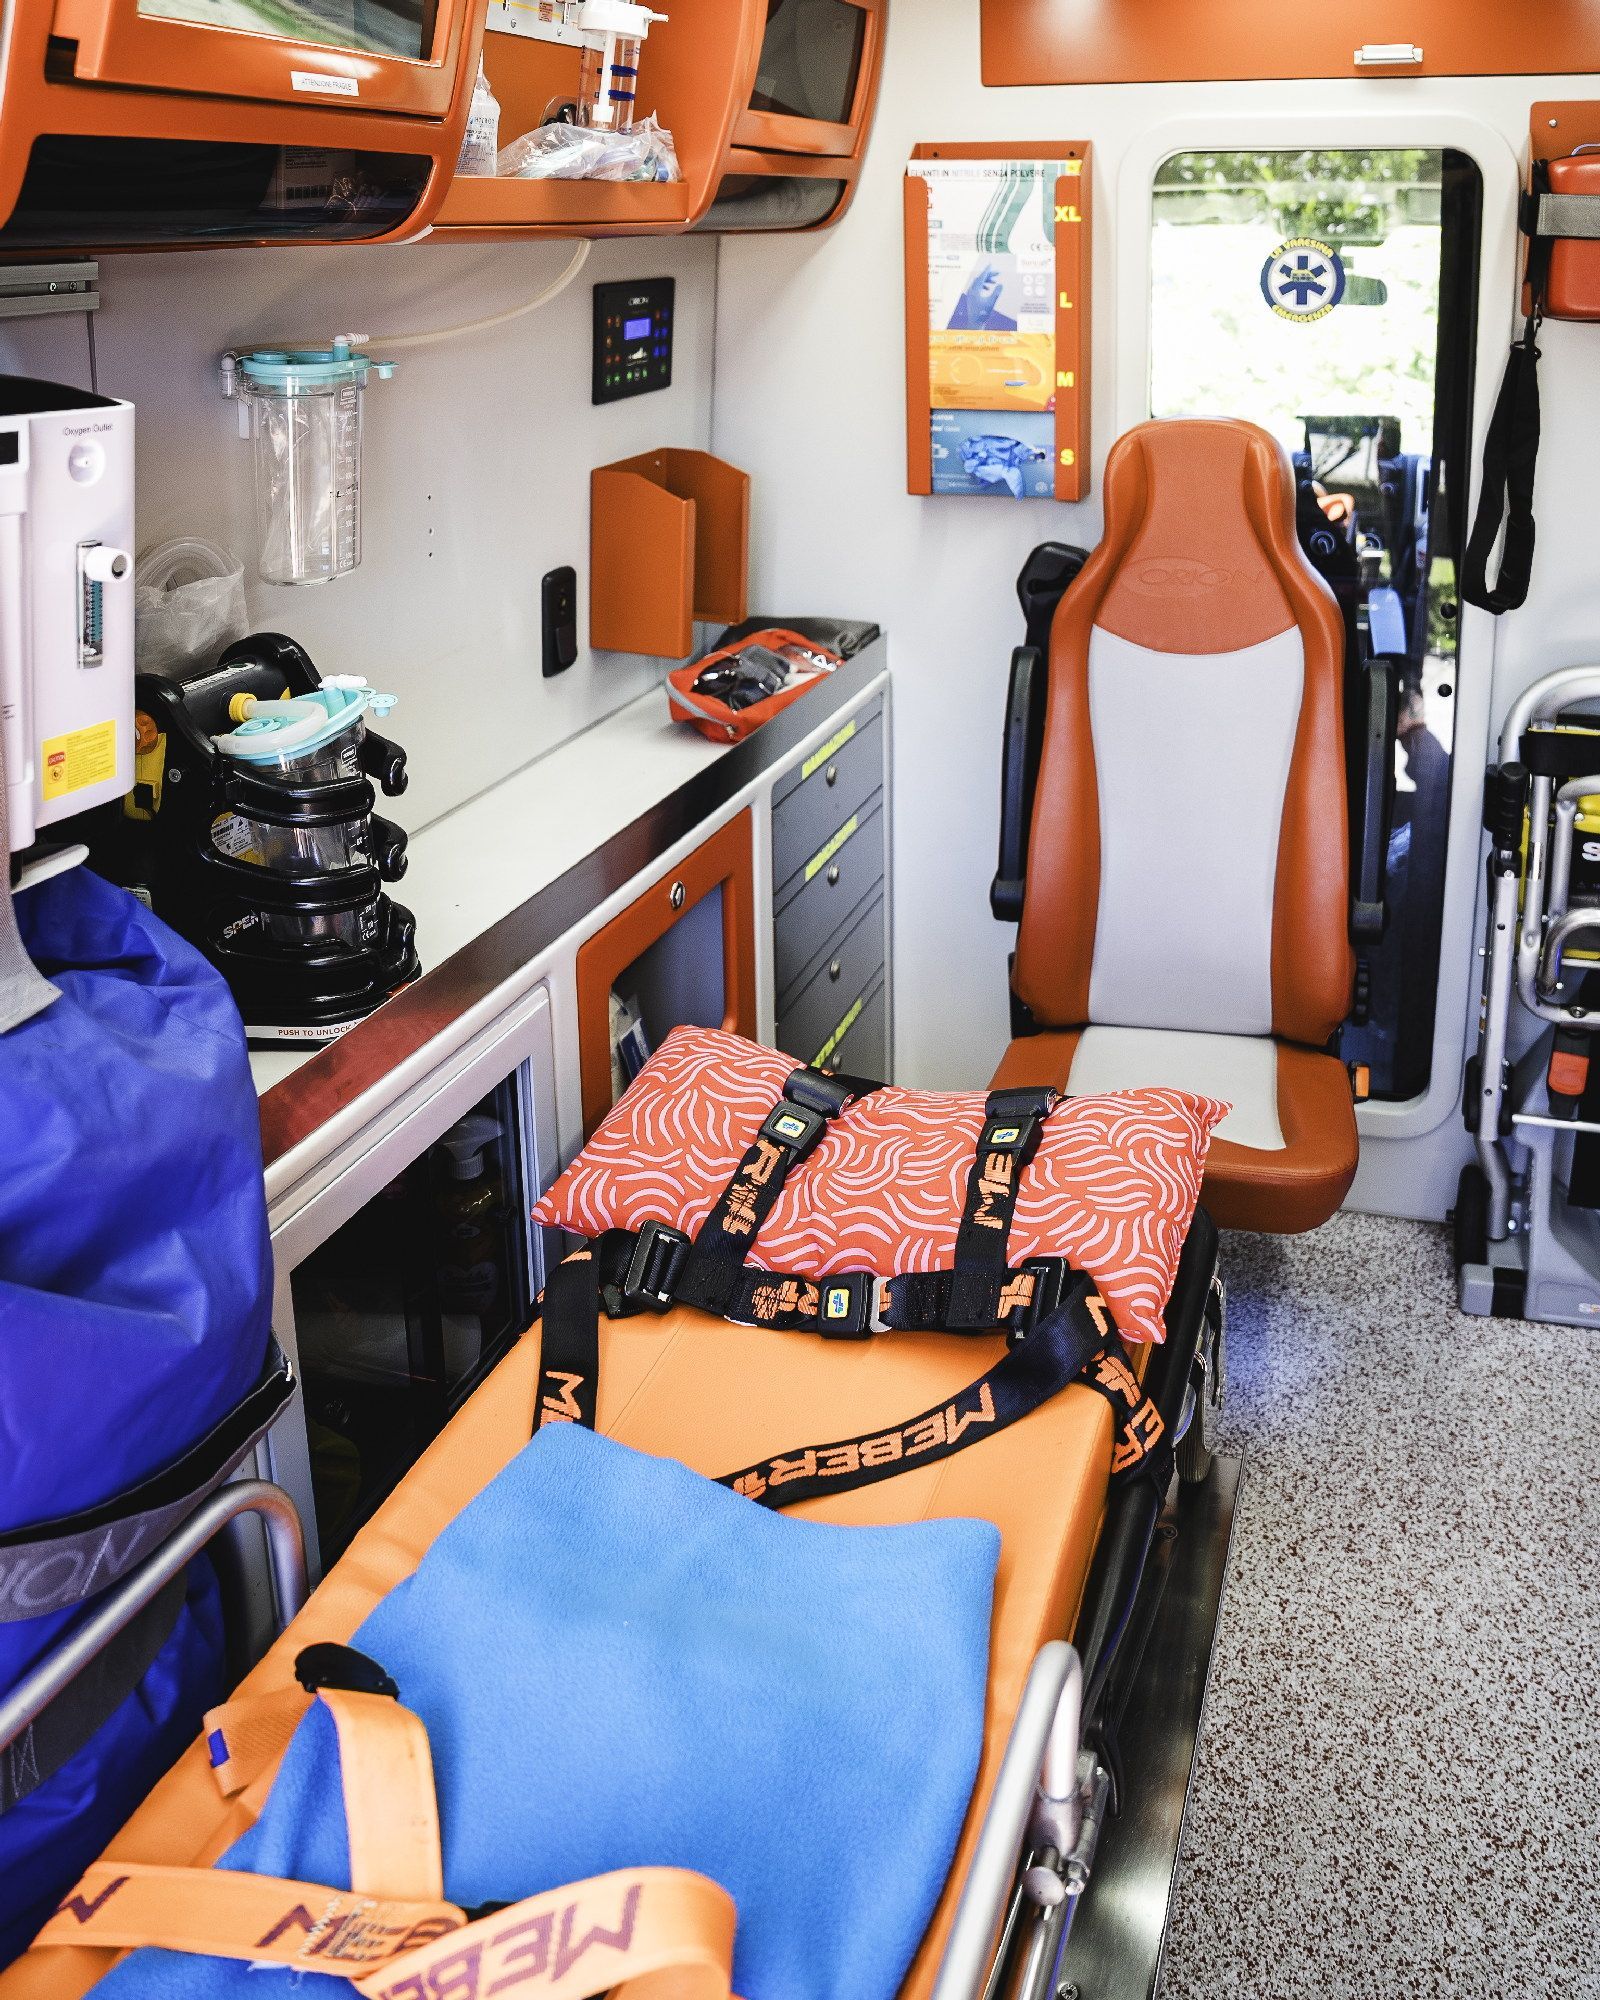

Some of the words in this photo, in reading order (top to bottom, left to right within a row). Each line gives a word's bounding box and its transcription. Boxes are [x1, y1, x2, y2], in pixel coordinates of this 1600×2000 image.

[910, 169, 939, 178] GUANTI
[941, 169, 949, 178] IN
[951, 169, 980, 178] NITRILE
[983, 169, 1008, 178] SENZA
[1010, 169, 1046, 178] POLVERE
[1054, 205, 1082, 223] XL
[1059, 291, 1073, 309] L
[1056, 371, 1075, 388] M
[64, 426, 92, 438] Oxygen
[1060, 448, 1075, 466] S
[302, 1029, 314, 1037] TO
[316, 1025, 352, 1037] UNLOCK
[769, 1381, 997, 1488] MEBER
